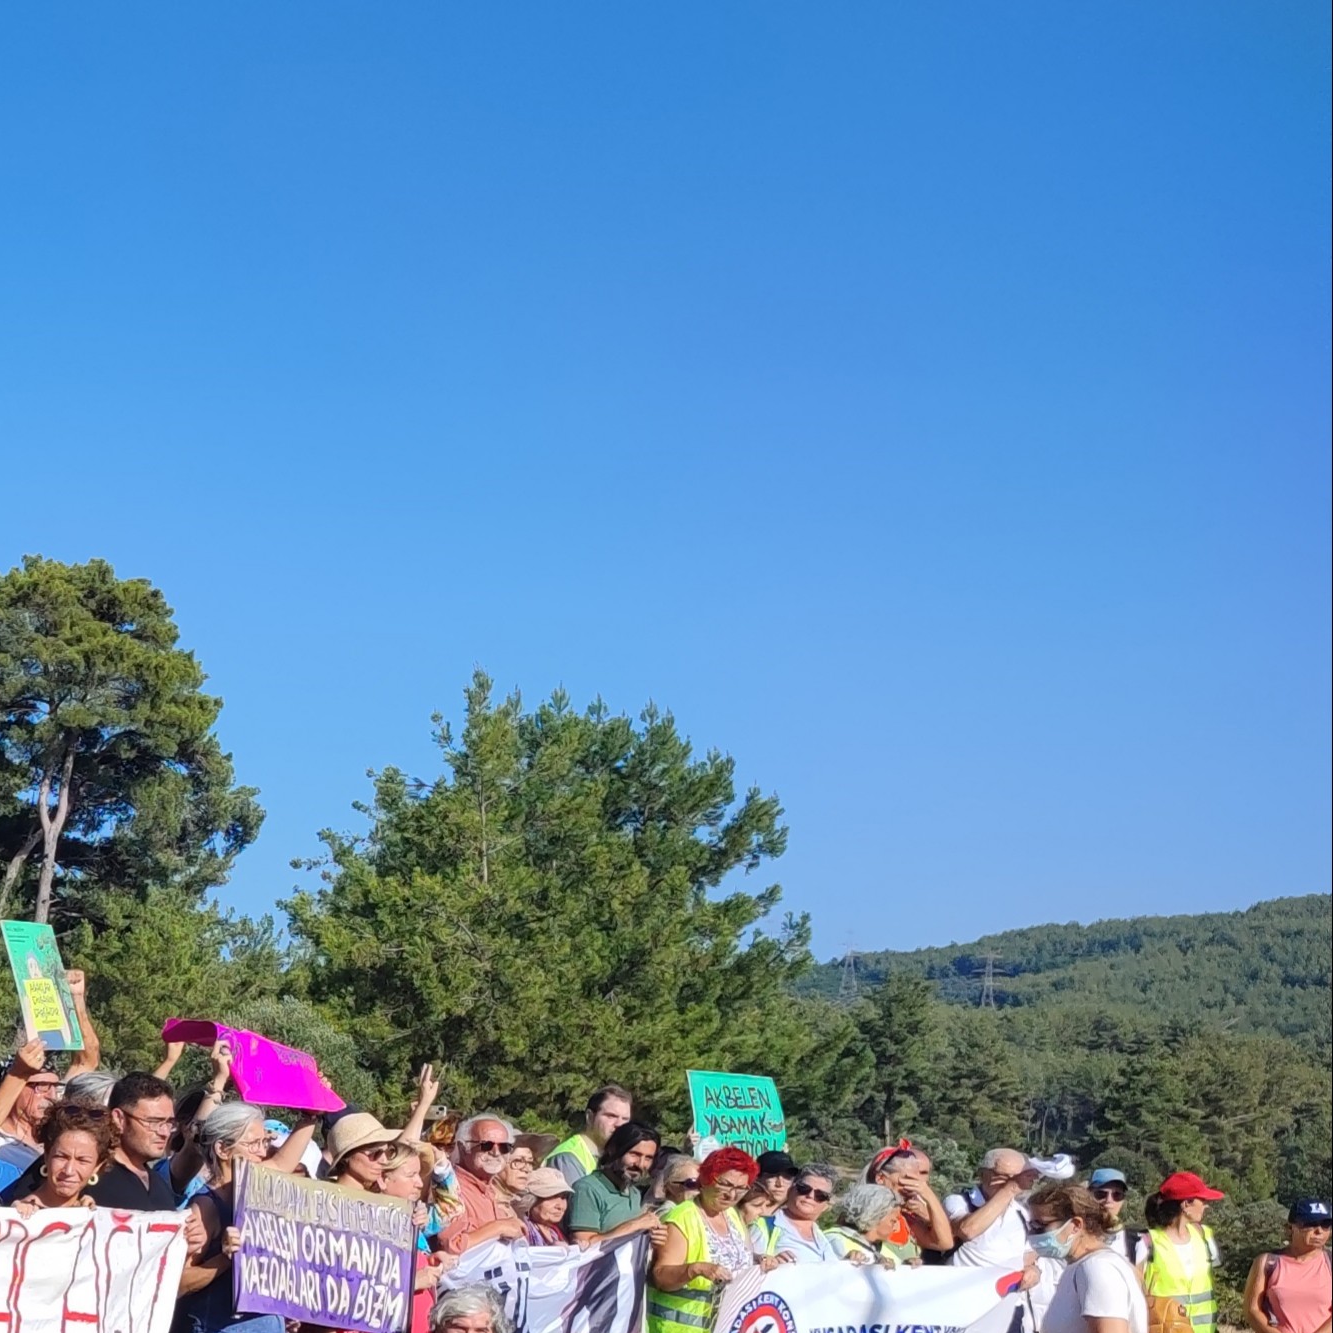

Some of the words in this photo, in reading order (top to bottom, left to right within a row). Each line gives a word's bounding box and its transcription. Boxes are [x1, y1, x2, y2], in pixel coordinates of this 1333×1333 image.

[705, 1085, 772, 1110] AKBELEN
[241, 1211, 298, 1261] AKBELEN
[382, 1247, 401, 1289] DA
[326, 1275, 350, 1315] DA
